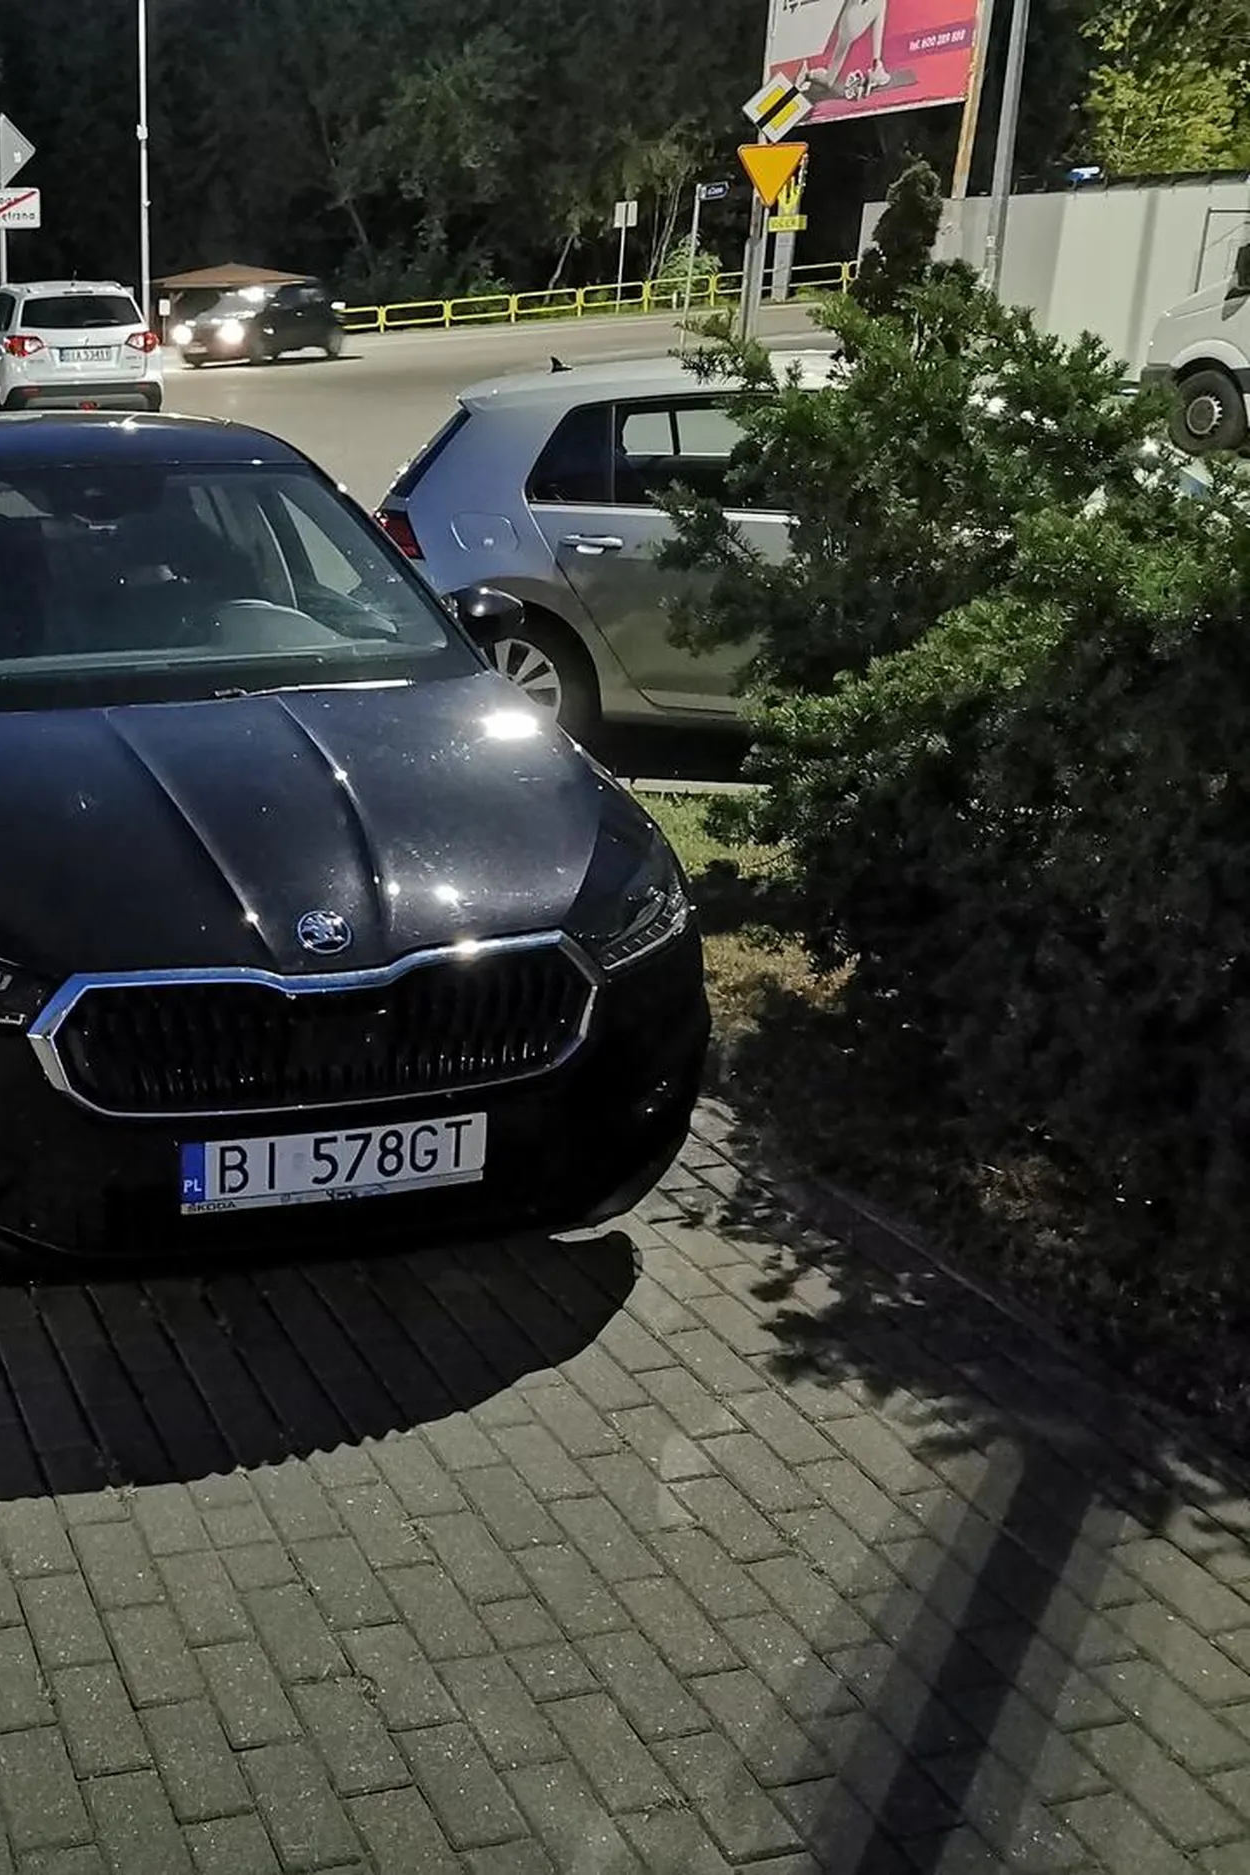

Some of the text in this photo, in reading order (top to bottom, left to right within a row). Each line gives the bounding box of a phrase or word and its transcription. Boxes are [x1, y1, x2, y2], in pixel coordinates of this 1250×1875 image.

[218, 1118, 473, 1194] BI 578GT
[183, 1178, 202, 1193] PL
